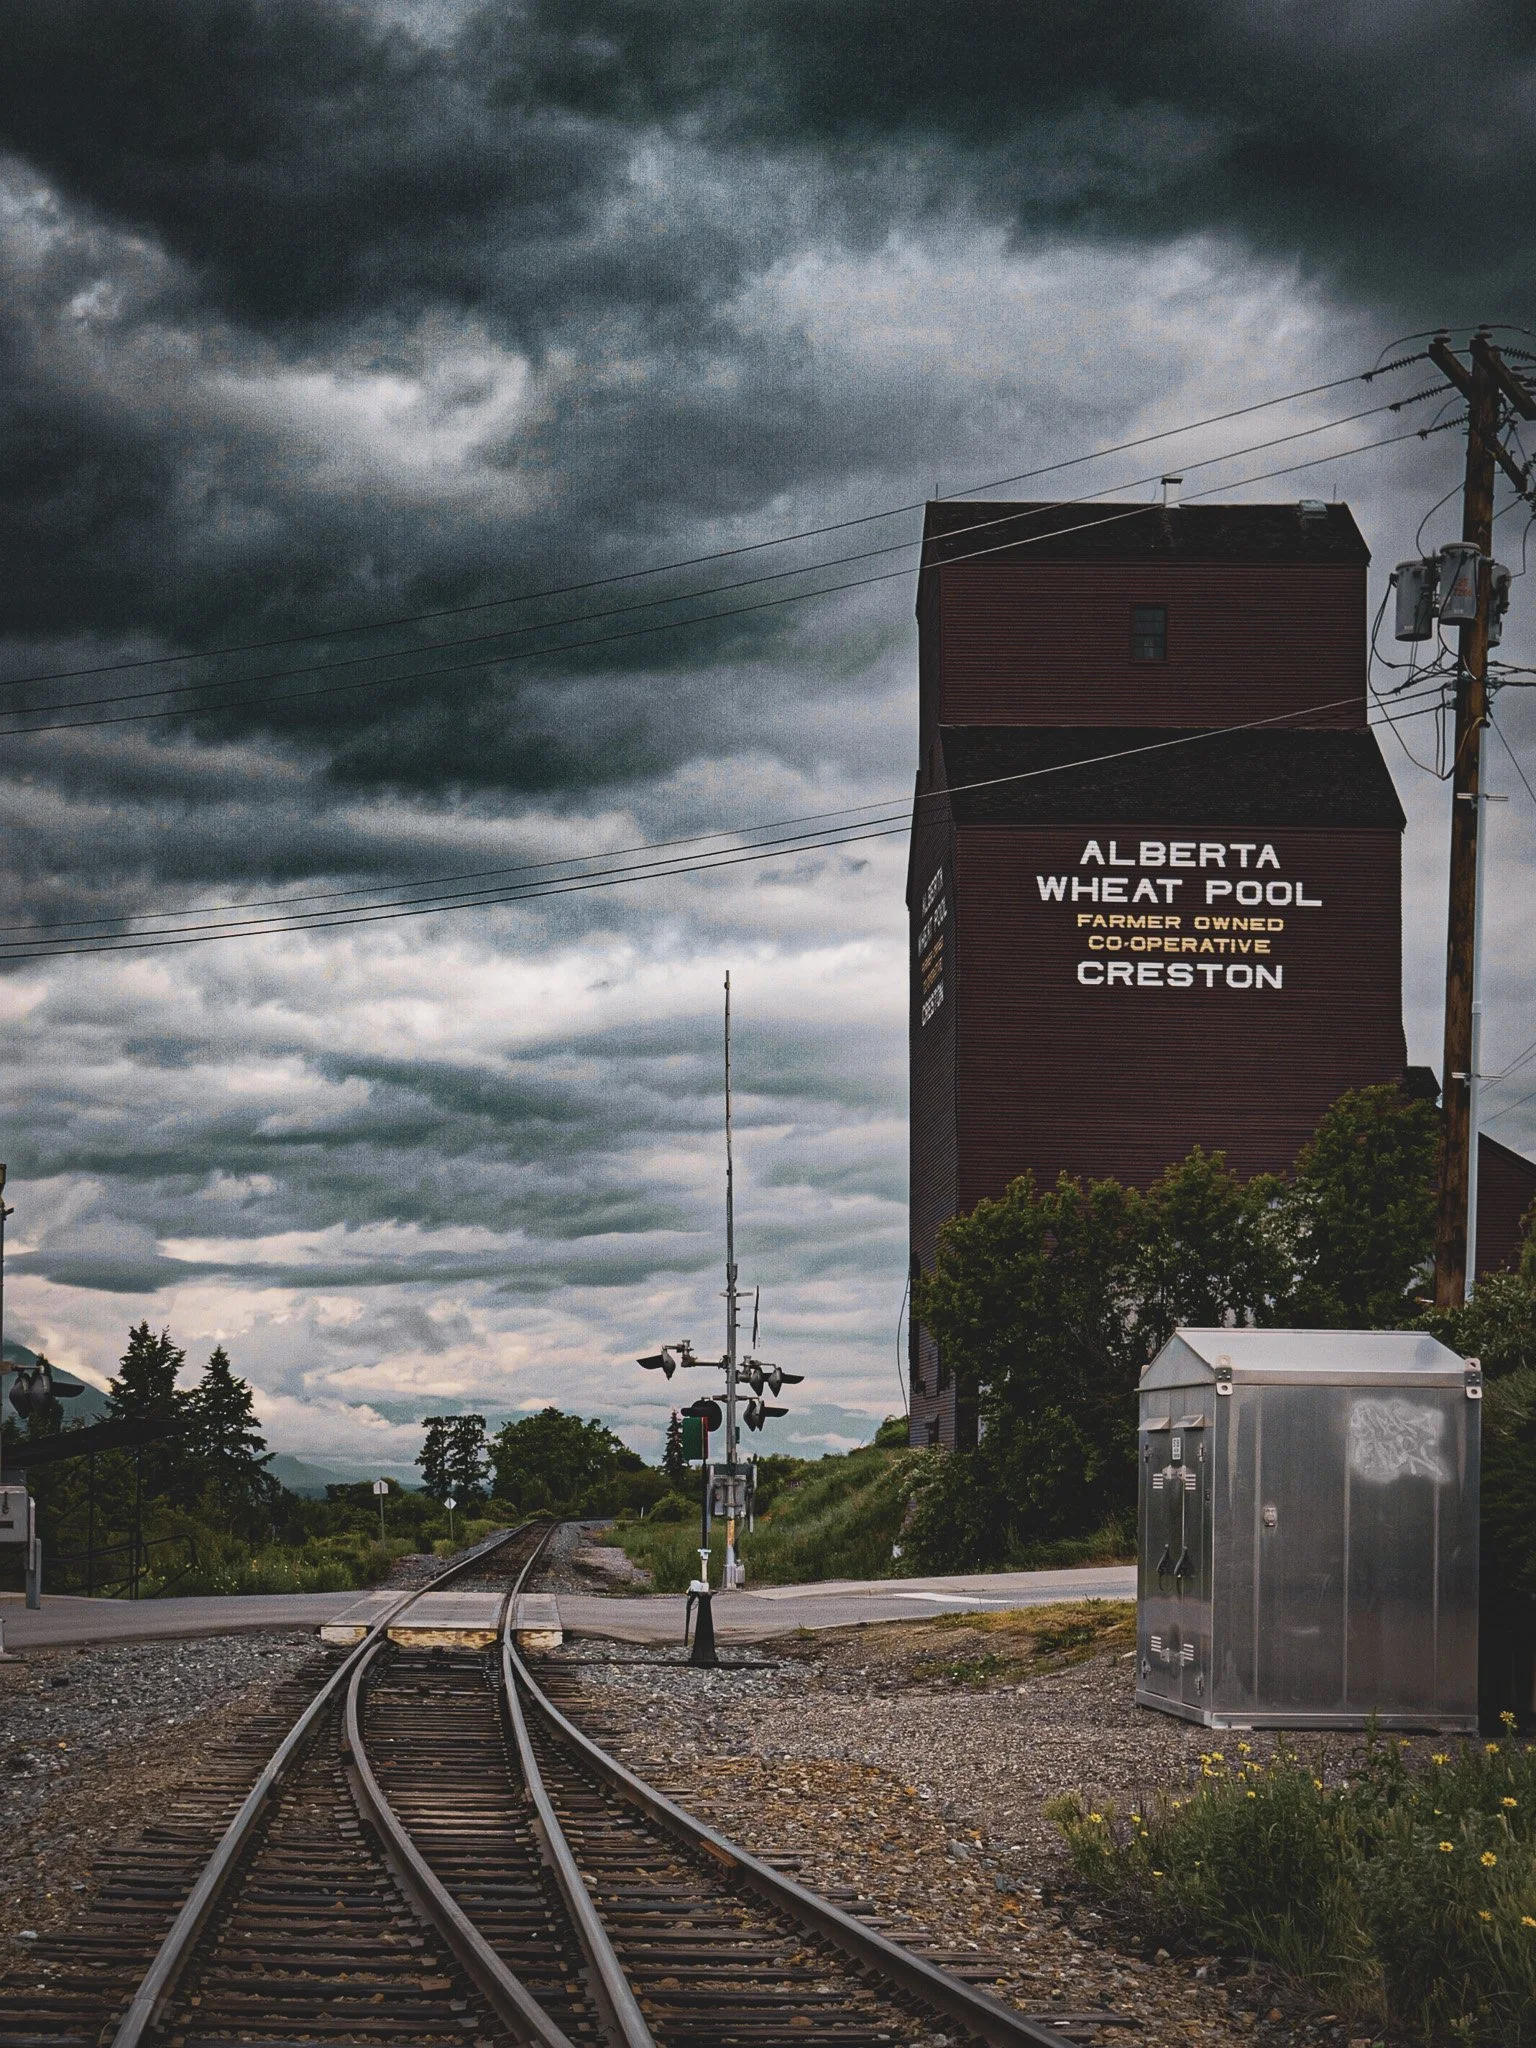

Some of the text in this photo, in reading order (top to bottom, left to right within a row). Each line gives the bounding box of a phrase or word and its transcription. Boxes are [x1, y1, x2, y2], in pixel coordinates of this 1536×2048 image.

[1080, 840, 1281, 869] ALBERTA
[1037, 876, 1322, 907] WHEAT POOL
[1077, 914, 1284, 931] FARMER OWNED
[1088, 936, 1271, 954] CO-OPERATIVE
[1077, 961, 1283, 989] CRESTON
